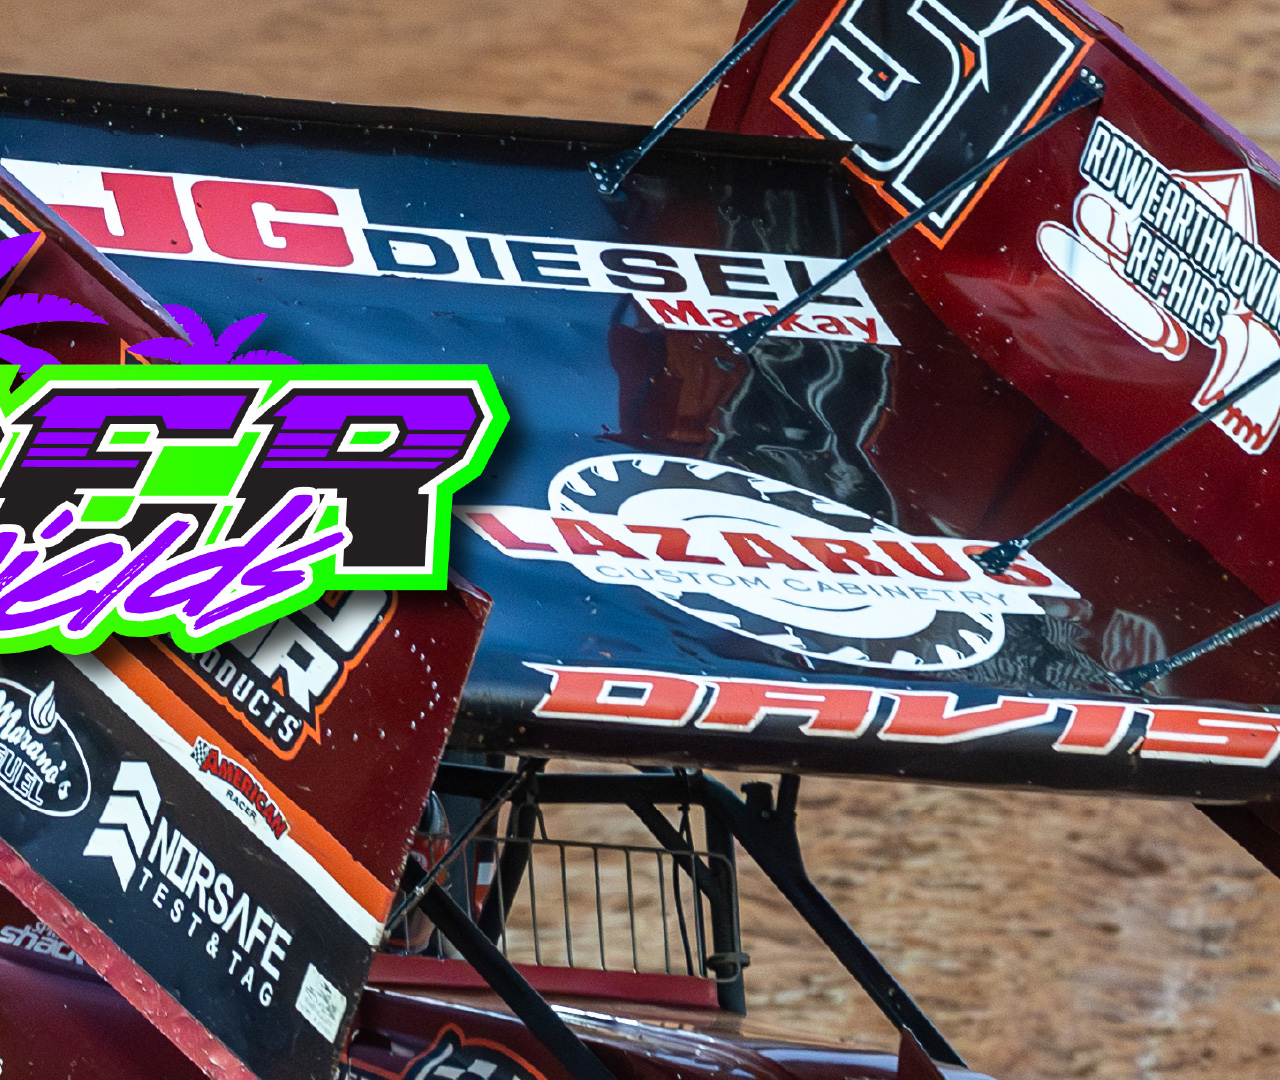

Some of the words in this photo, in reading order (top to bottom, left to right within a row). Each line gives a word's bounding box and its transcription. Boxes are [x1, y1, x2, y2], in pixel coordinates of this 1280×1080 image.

[1082, 124, 1152, 208] RDW
[45, 172, 354, 267] JG
[363, 228, 863, 307] DIESEL
[1125, 225, 1230, 343] REPAIRS
[467, 511, 1054, 587] LAZARUS
[596, 564, 763, 590] CUSTOM
[783, 576, 1011, 608] CABINETRY
[190, 645, 301, 743] ODUCTS
[199, 748, 289, 840] AMERICAN
[226, 789, 257, 820] RACER
[140, 867, 202, 937] TEST
[206, 931, 220, 959] &
[228, 950, 274, 1007] TAG
[148, 816, 293, 981] NORSAFE
